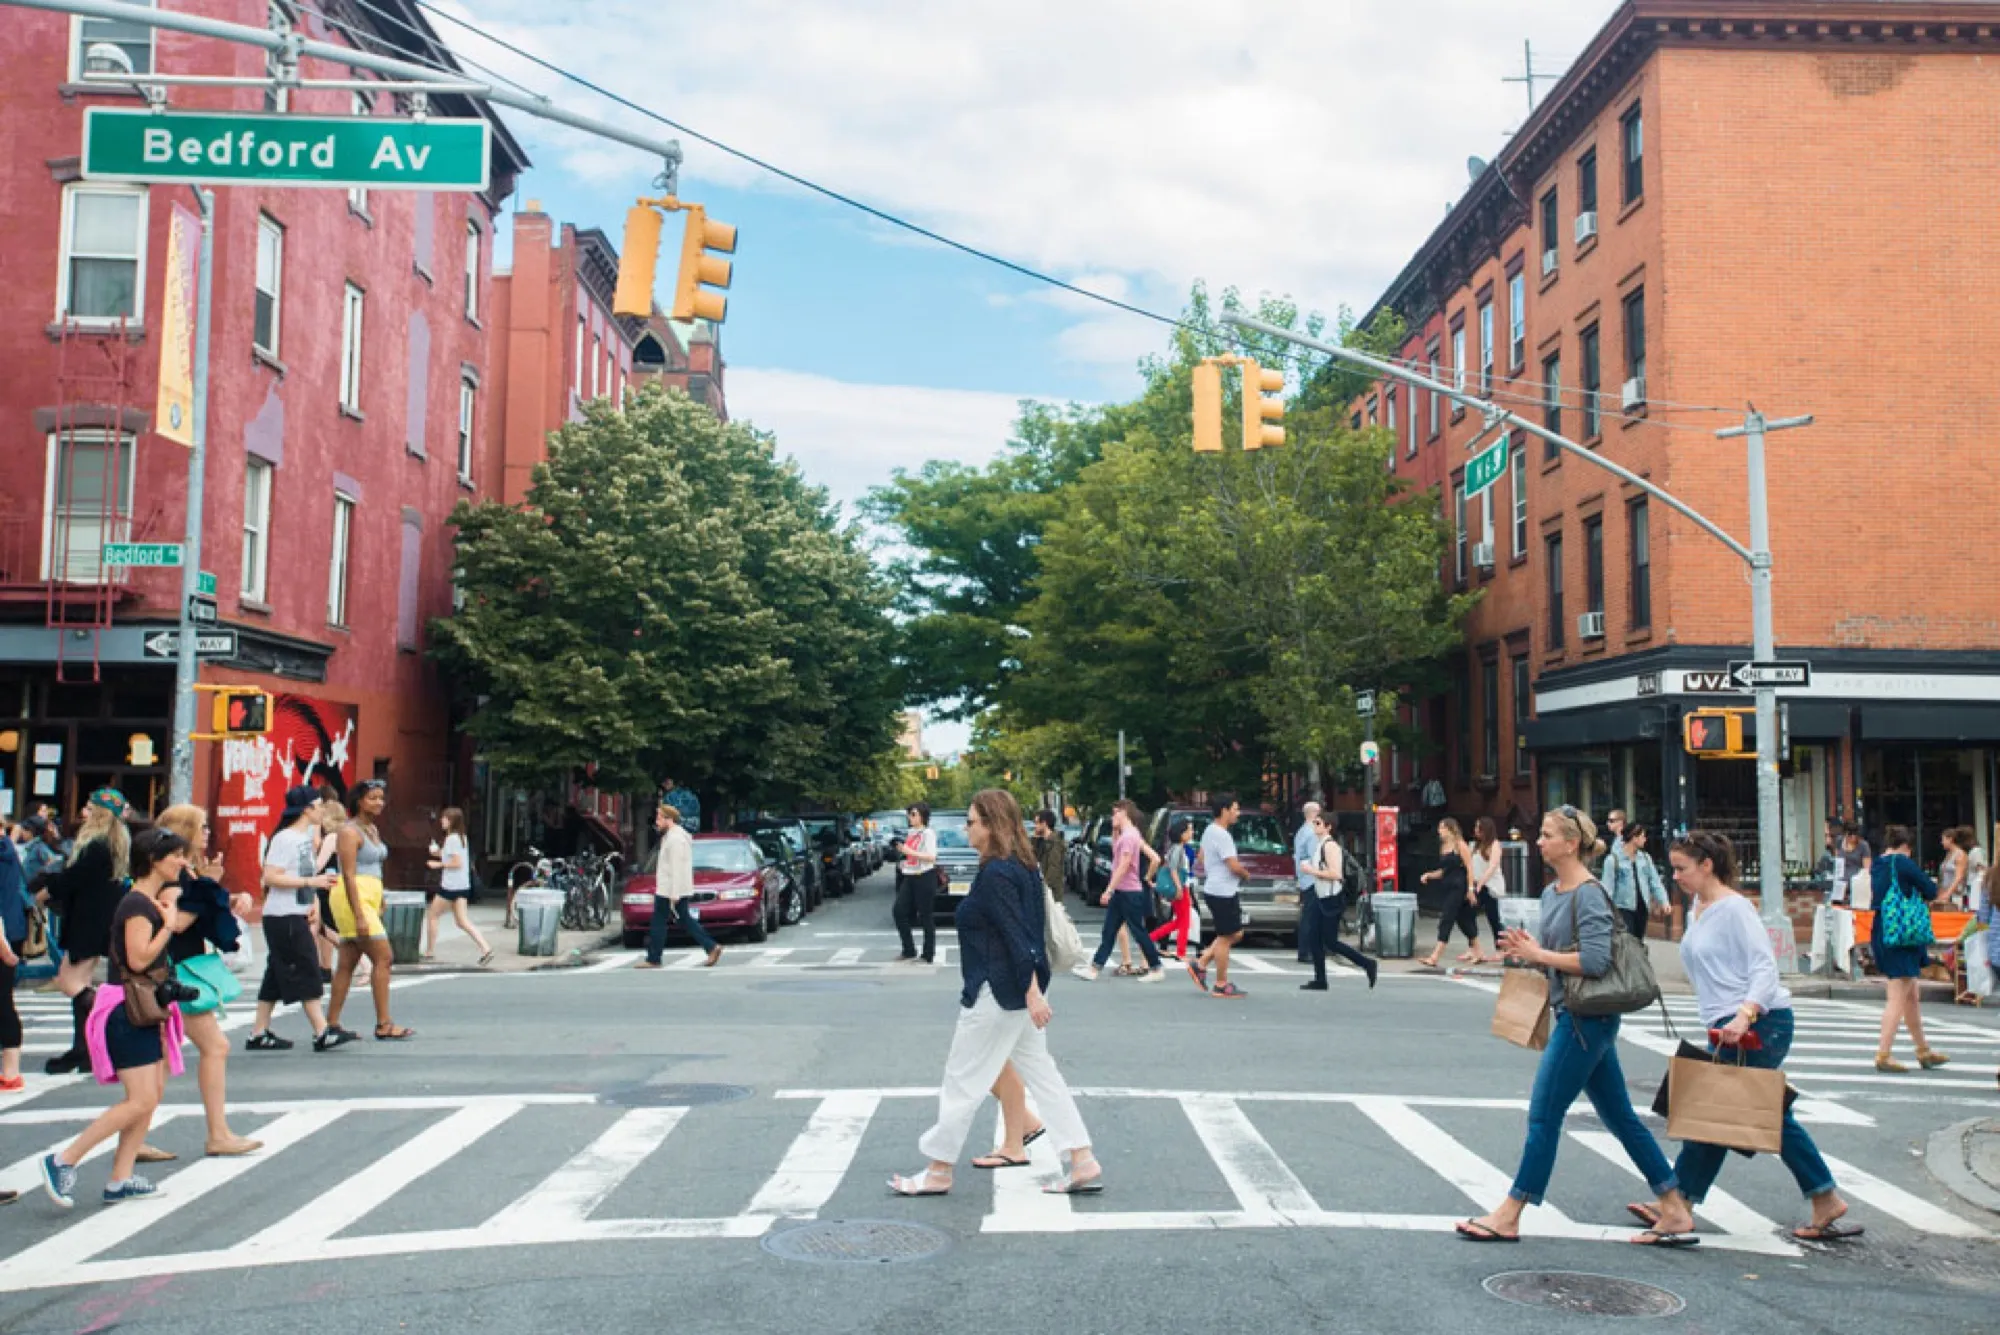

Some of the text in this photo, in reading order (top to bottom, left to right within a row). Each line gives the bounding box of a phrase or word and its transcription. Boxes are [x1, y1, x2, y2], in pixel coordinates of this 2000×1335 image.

[143, 128, 432, 171] Bedford Av
[105, 545, 163, 564] Bedford
[198, 639, 223, 649] WAY
[1687, 674, 1730, 690] UVA
[1741, 669, 1799, 680] ONE WAY
